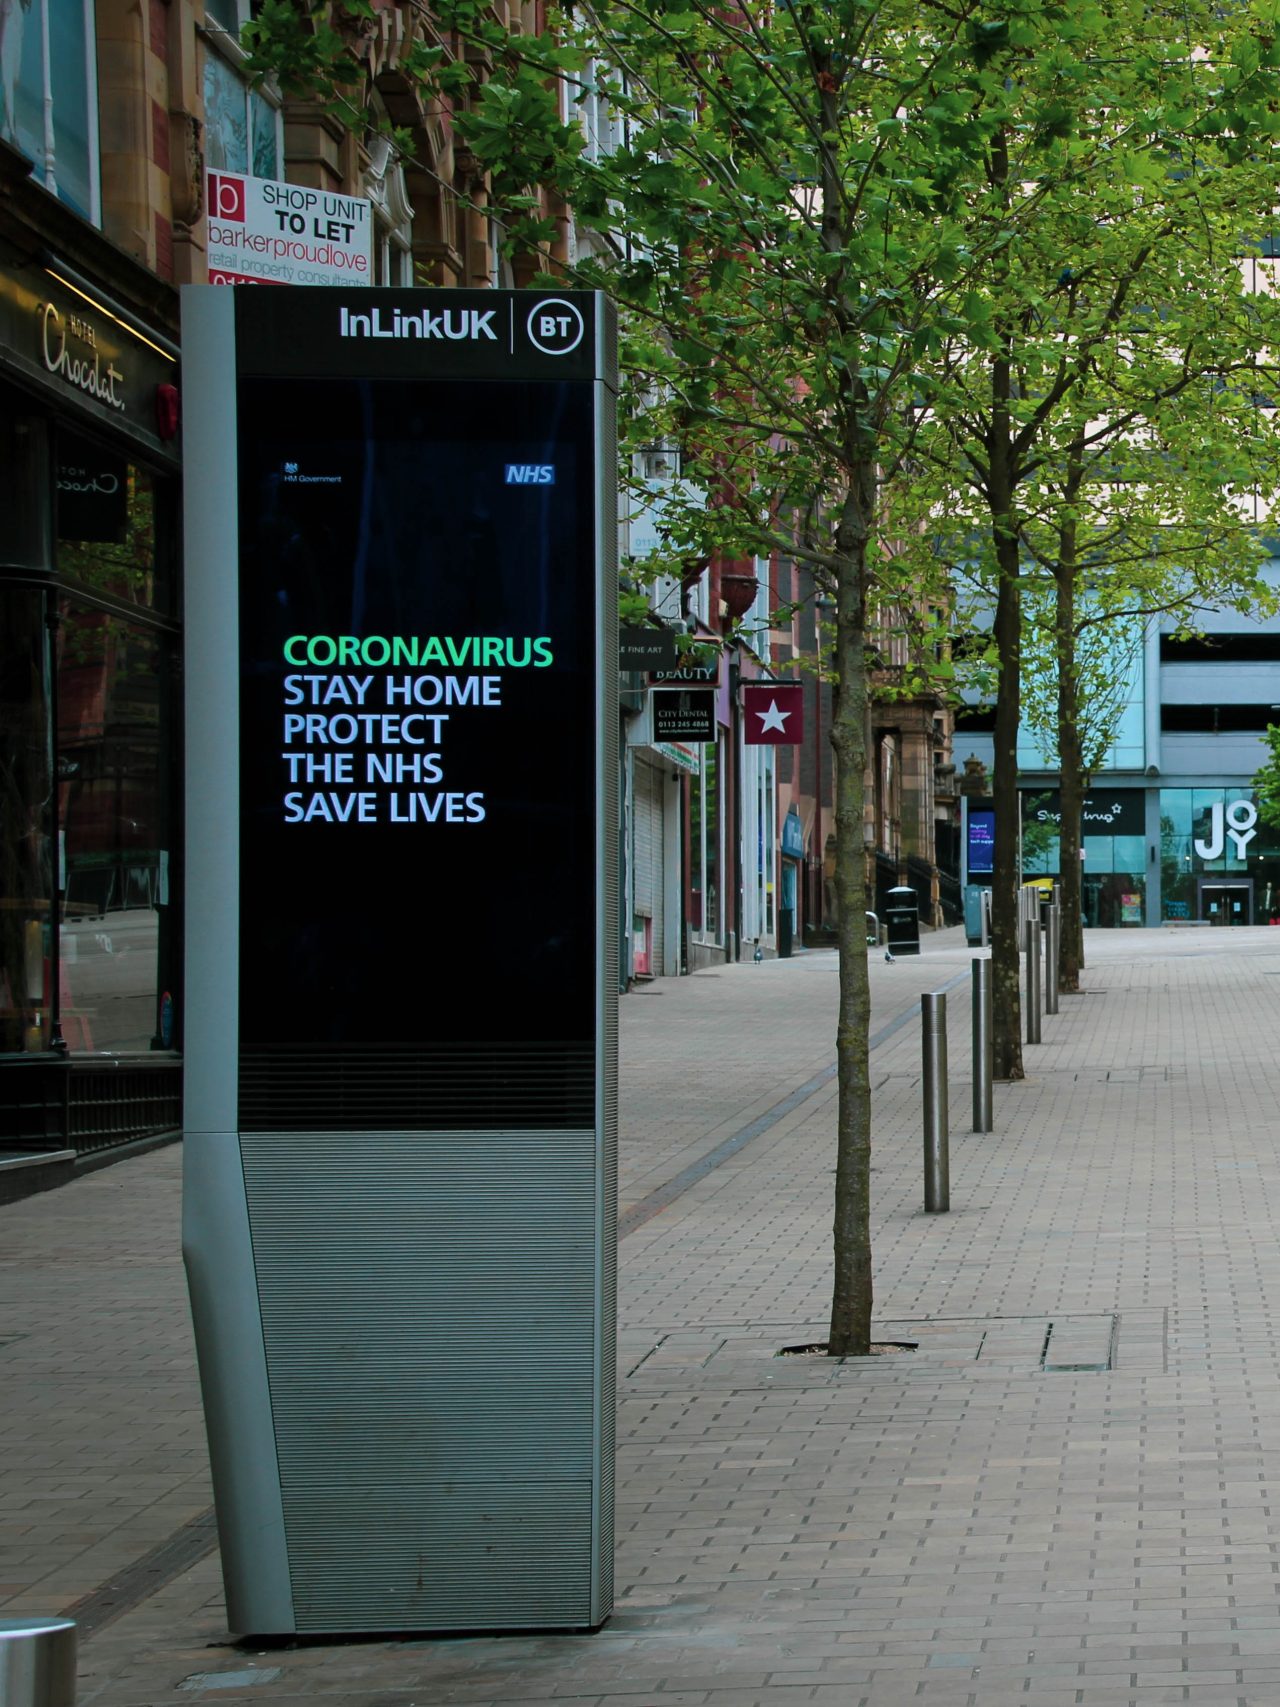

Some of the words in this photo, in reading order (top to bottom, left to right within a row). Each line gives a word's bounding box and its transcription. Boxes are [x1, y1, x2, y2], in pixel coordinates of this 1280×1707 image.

[263, 184, 317, 211] SHOP
[324, 197, 367, 221] UNIT
[275, 209, 306, 234] TO
[314, 218, 355, 243] LET
[208, 220, 367, 272] barkerproudlove
[209, 252, 237, 268] retail
[241, 258, 294, 281] property
[70, 314, 97, 348] HOTEL
[340, 307, 498, 340] InLinkUK
[540, 316, 572, 337] BT
[299, 475, 342, 483] Government
[506, 466, 553, 483] NHS
[284, 635, 554, 667] CORONAVIRUS
[647, 646, 663, 654] ART
[284, 674, 375, 705] STAY
[386, 675, 501, 706] HOME
[284, 713, 450, 744] PROTECT
[658, 710, 677, 718] CITY
[679, 709, 708, 718] DENTAL
[282, 753, 354, 783] THE
[367, 753, 444, 784] NHS
[284, 792, 377, 822] SAVE
[390, 792, 486, 822] LIVES
